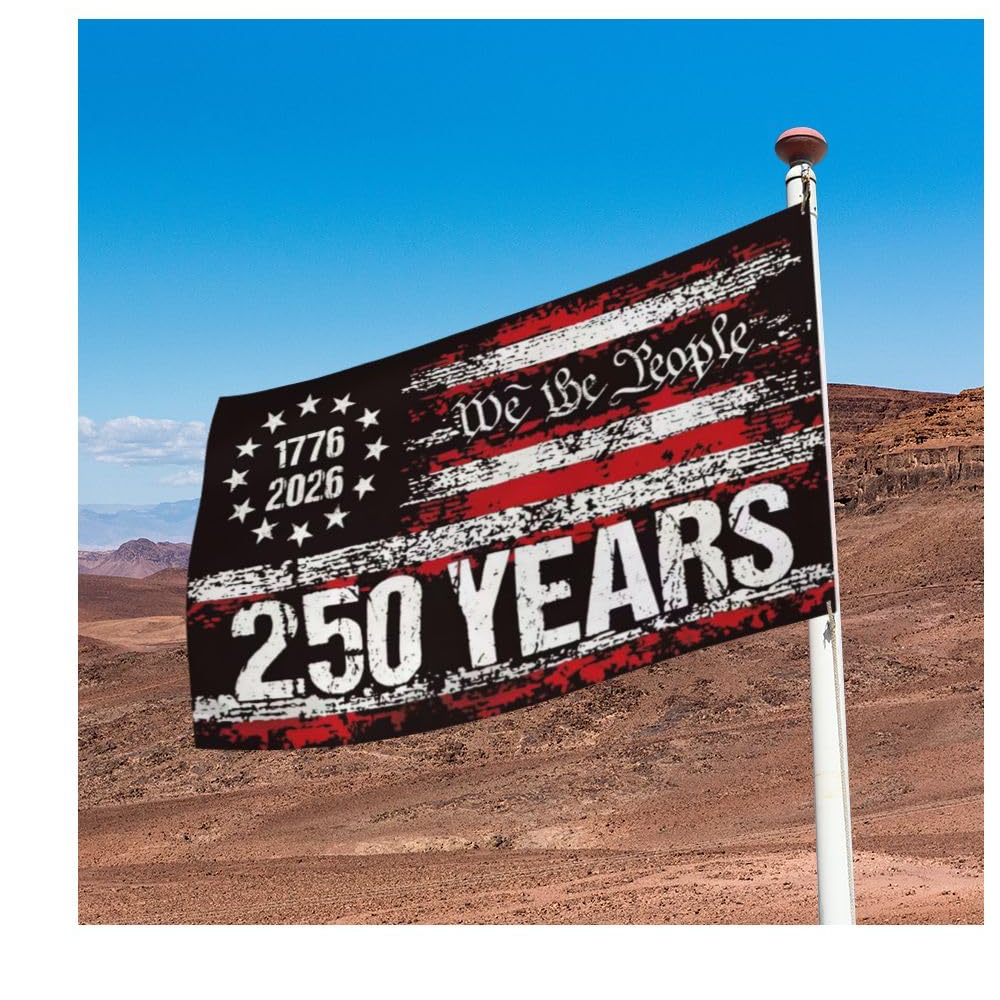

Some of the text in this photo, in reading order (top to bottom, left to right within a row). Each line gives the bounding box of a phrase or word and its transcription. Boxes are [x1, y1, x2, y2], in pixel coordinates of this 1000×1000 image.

[452, 312, 756, 443] We the People
[265, 466, 344, 511] 2026
[274, 426, 345, 469] 1776
[230, 482, 795, 702] 250 YEARS
